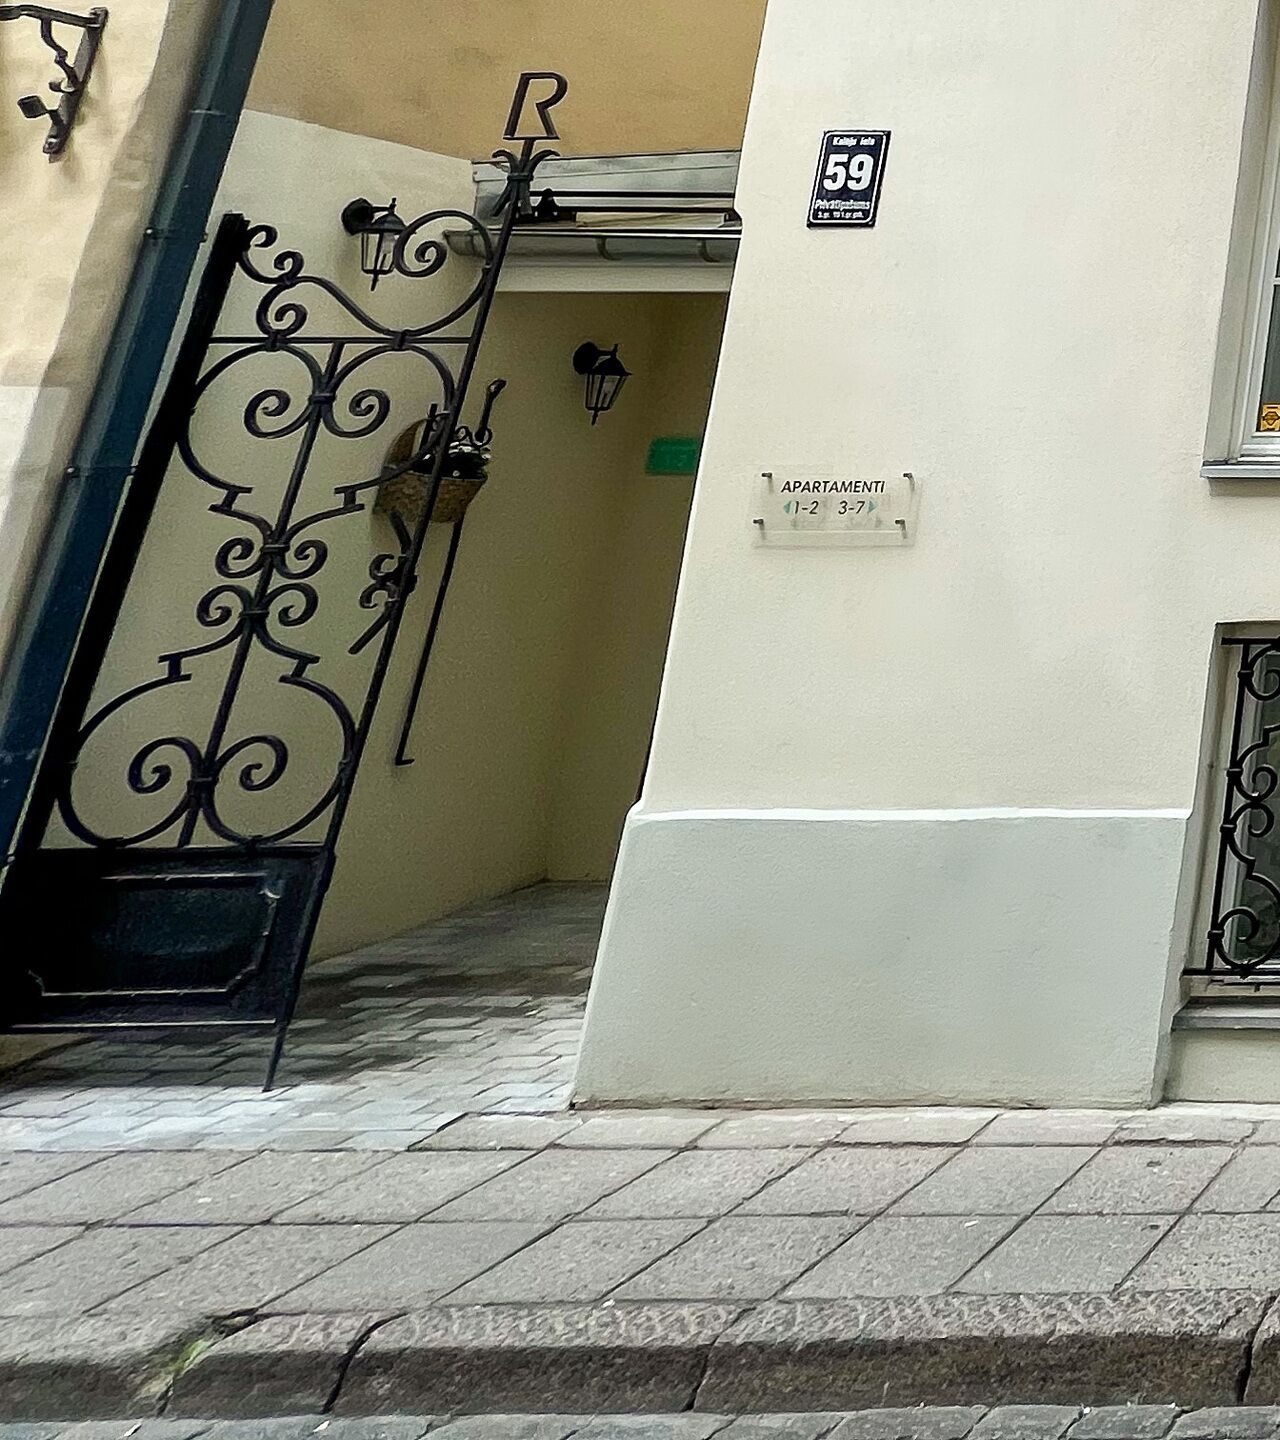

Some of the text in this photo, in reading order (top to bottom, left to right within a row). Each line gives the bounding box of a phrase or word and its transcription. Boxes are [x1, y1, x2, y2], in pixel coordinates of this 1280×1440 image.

[823, 153, 874, 191] 59
[781, 480, 885, 493] APARTAMENTI
[794, 500, 866, 515] 1-2 3-7
